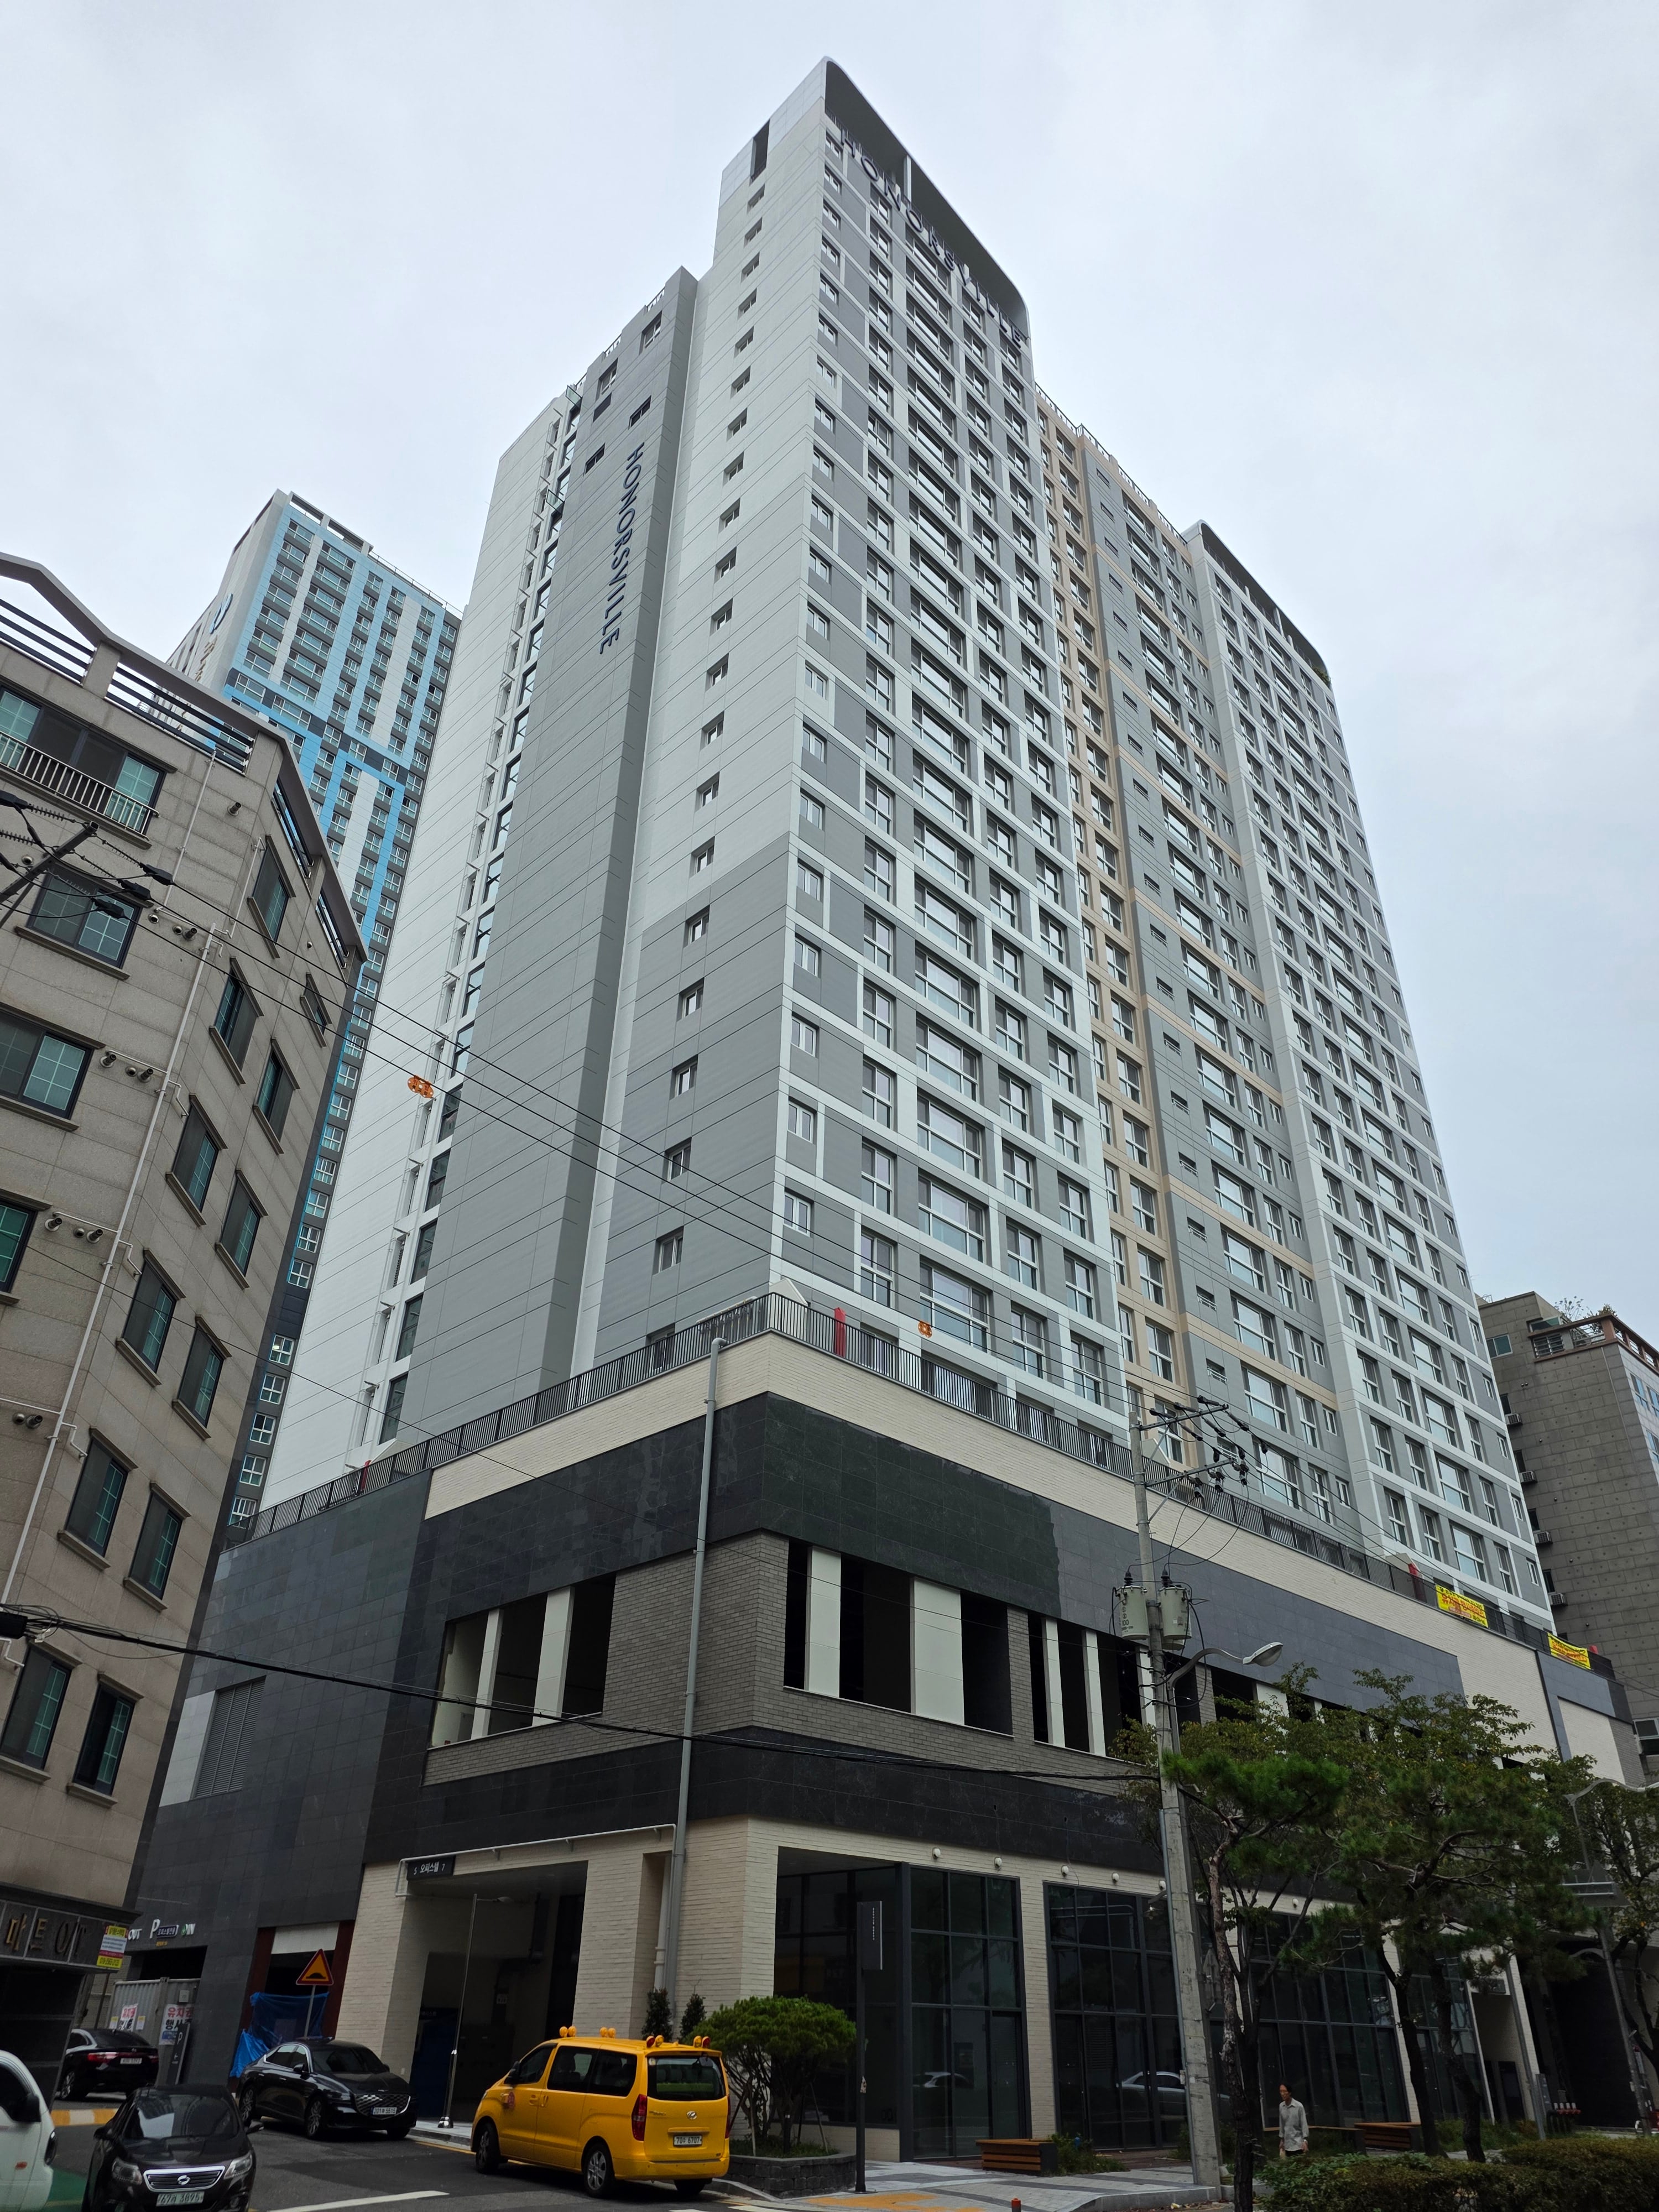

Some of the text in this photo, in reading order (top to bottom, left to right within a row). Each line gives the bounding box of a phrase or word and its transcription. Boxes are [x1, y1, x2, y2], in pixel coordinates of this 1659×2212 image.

[841, 129, 1021, 348] HONORSVILLE
[599, 442, 645, 654] HONORSVILLE
[420, 1861, 440, 1874] 오피스텔
[128, 1928, 142, 1940] OUT
[149, 1919, 160, 1939] P
